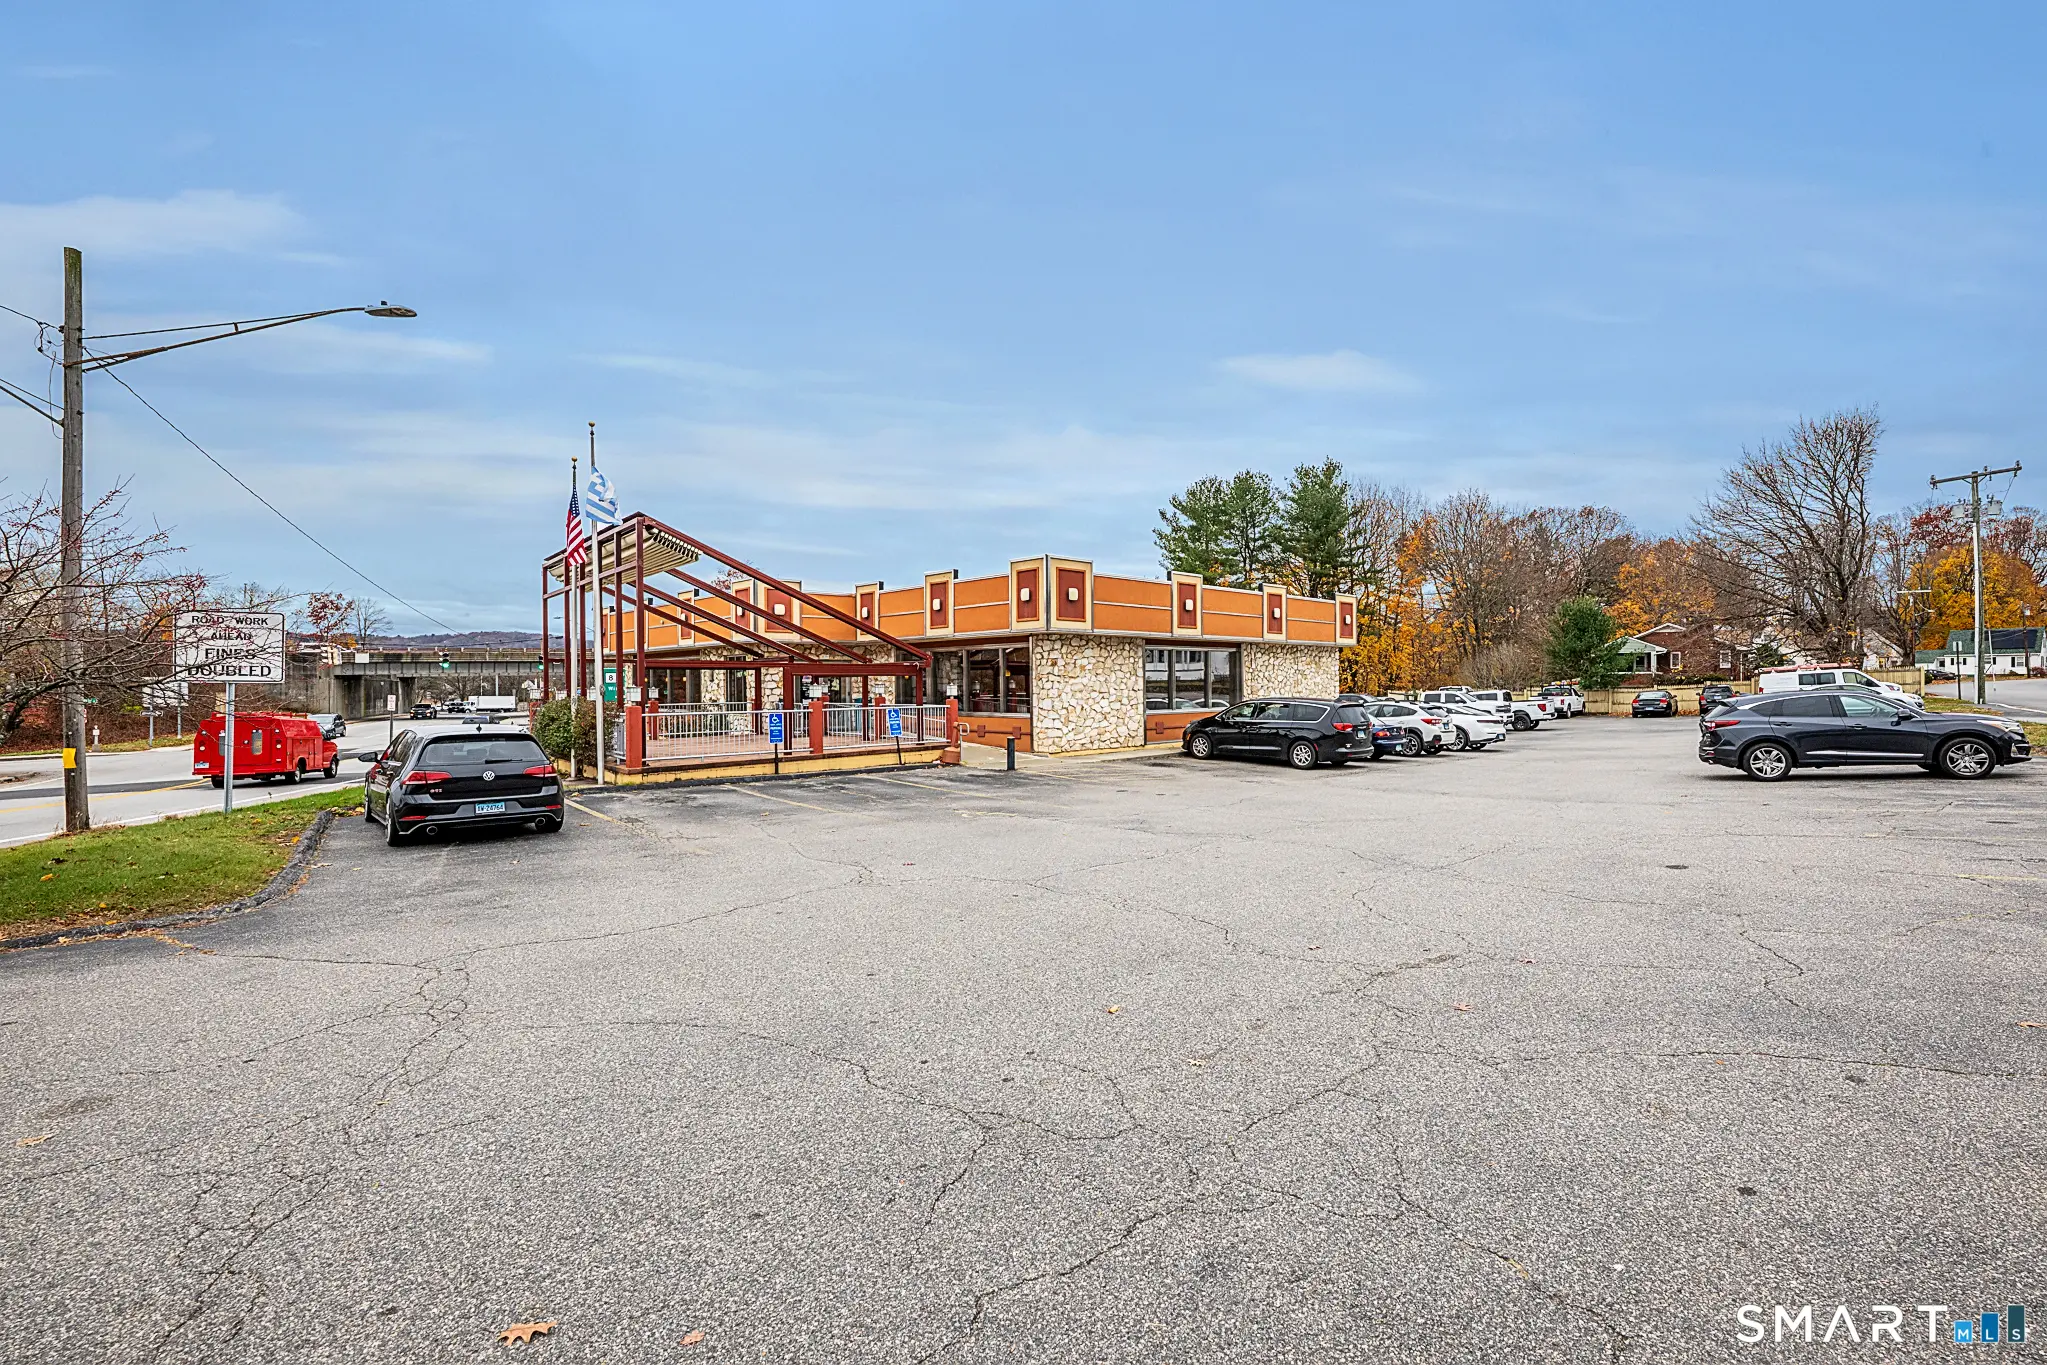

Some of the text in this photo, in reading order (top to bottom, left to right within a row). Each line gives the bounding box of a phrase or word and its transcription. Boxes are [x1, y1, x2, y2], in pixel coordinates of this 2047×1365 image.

[191, 615, 269, 626] ROAD WORK
[211, 632, 252, 641] AHEAD
[205, 648, 256, 660] FINES
[188, 665, 271, 677] DOUBLED
